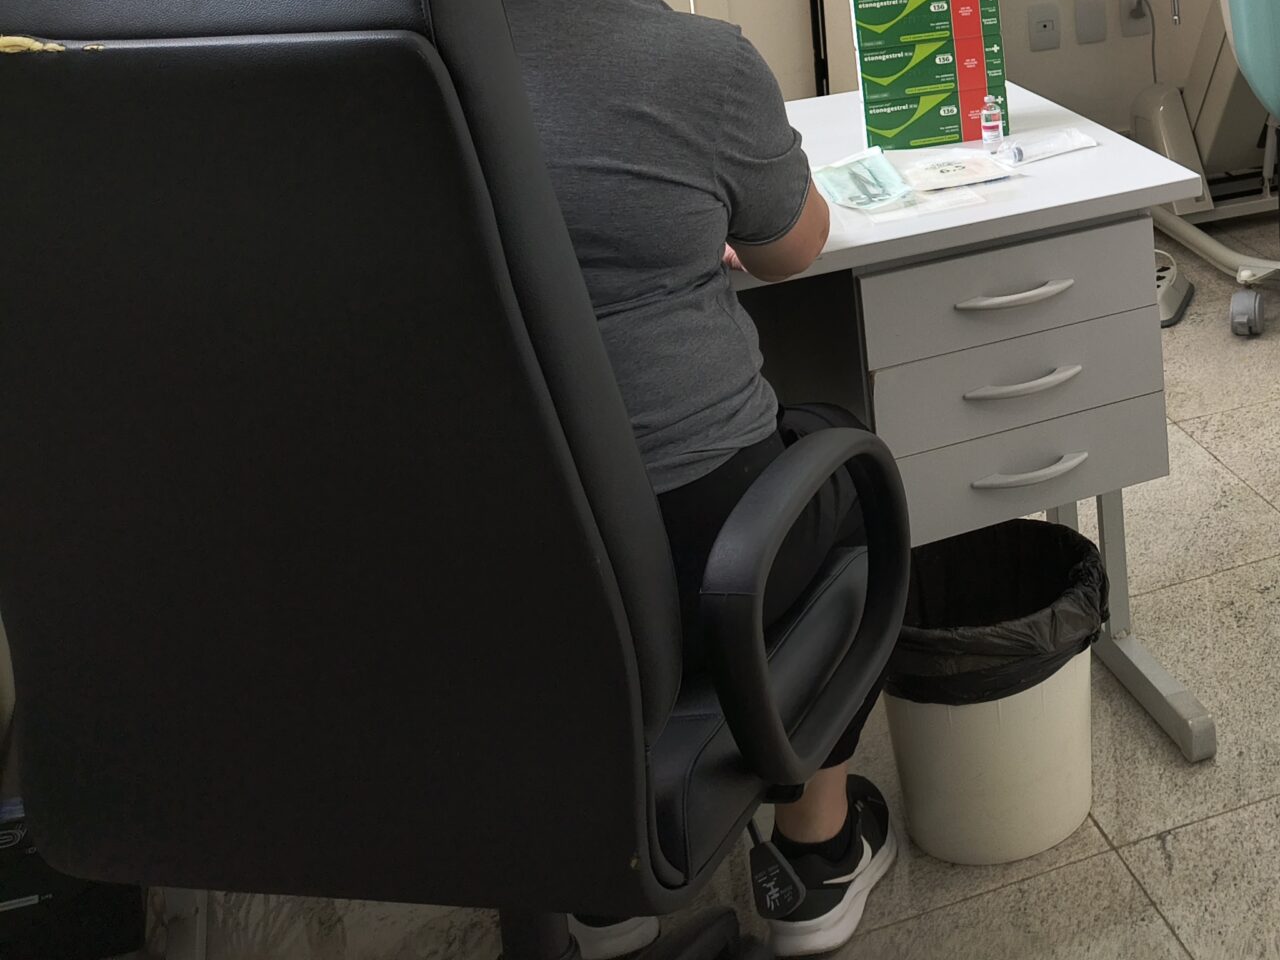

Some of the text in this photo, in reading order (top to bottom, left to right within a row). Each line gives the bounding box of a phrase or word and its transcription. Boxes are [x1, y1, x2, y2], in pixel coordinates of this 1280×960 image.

[858, 0, 898, 8] etonogestrel
[864, 52, 903, 61] etonogestrel
[869, 104, 908, 114] etonogestrel
